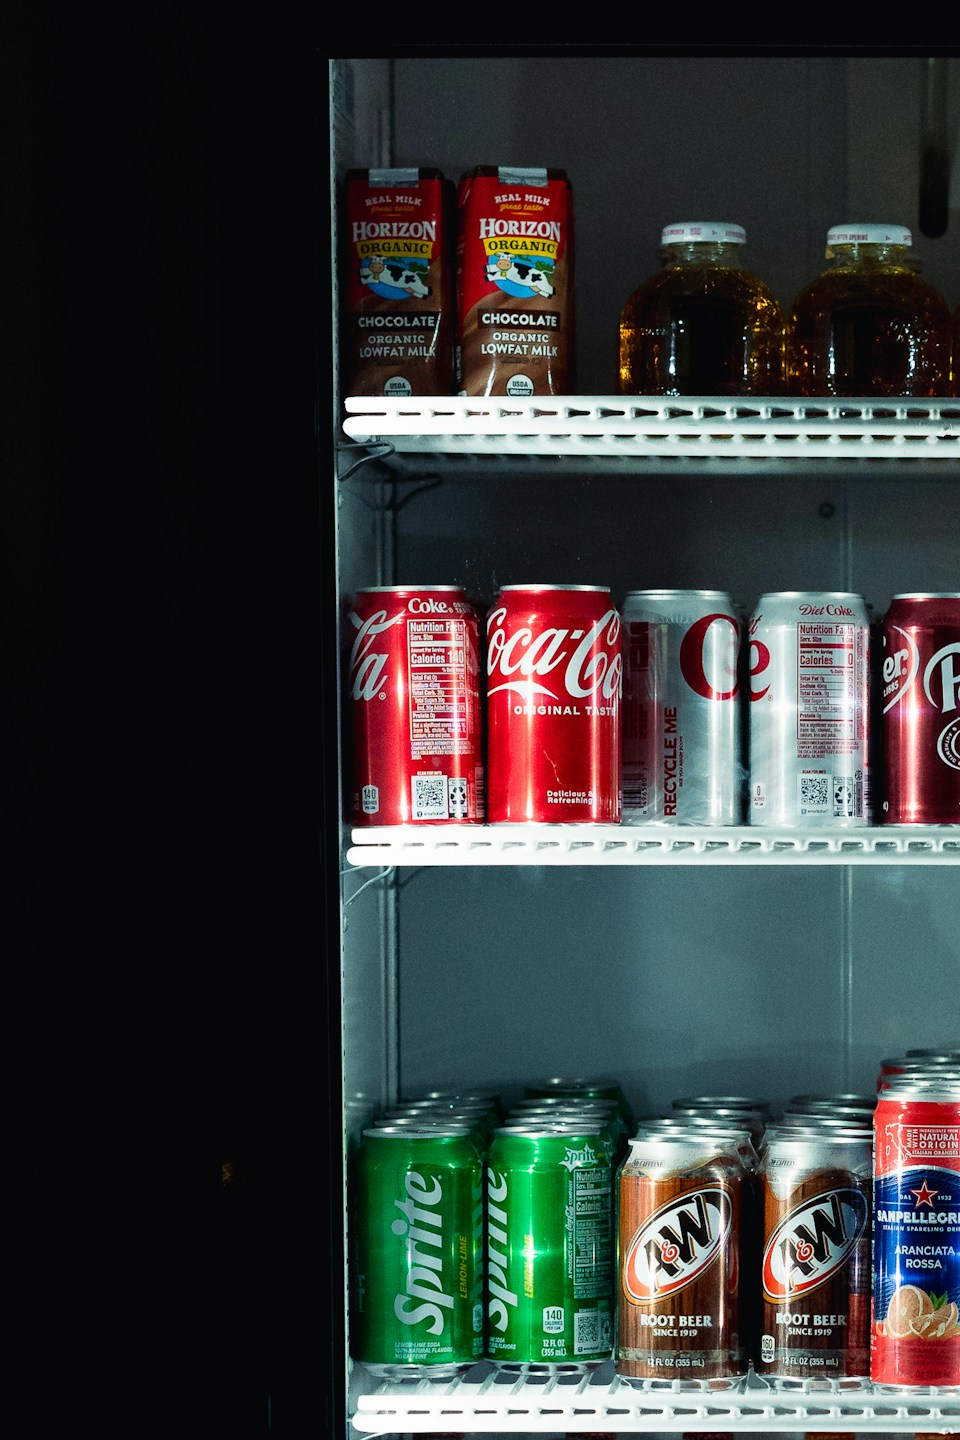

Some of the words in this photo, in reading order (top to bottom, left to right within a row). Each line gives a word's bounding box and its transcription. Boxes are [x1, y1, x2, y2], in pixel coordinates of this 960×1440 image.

[365, 196, 392, 206] REAL
[395, 195, 422, 206] MILK
[495, 194, 521, 204] REAL
[524, 193, 551, 206] MILK
[353, 220, 436, 242] HORIZON
[479, 218, 561, 242] HORIZON
[360, 242, 430, 255] ORGANIC
[488, 240, 556, 254] ORGANIC
[358, 316, 435, 327] CHOCOLATE
[482, 313, 557, 327] CHOCOLATE
[368, 335, 425, 344] ORGANIC
[492, 332, 549, 343] ORGANIC
[359, 346, 405, 358] LOWFAT
[407, 345, 436, 357] MILK
[481, 343, 528, 356] LOWFAT
[531, 344, 558, 357] MILK
[408, 597, 448, 614] Coke
[410, 621, 444, 633] Nutrition
[445, 621, 463, 632] Fcts
[800, 655, 833, 665] Calories
[848, 652, 854, 666] 0
[663, 707, 677, 734] ME
[663, 738, 677, 816] RECYCLE
[547, 797, 593, 805] Refreshing
[920, 1133, 959, 1141] NATURAL
[920, 1141, 959, 1149] ORIGIN
[565, 1149, 596, 1165] Sprite
[643, 1193, 716, 1293] A&W
[778, 1193, 850, 1293] A&W
[391, 1171, 455, 1336] Sprite
[894, 1246, 955, 1256] ARANCIATA
[460, 1235, 468, 1300] LEMON-LIME
[905, 1259, 942, 1269] ROSSA
[545, 1310, 562, 1320] 140
[640, 1314, 676, 1326] ROOT
[678, 1315, 713, 1327] BEER
[776, 1313, 811, 1325] ROOT
[813, 1313, 847, 1326] BEER
[652, 1328, 678, 1336] SINCE
[679, 1329, 698, 1337] 1919
[787, 1327, 813, 1336] SINCE
[814, 1327, 832, 1336] 1919
[543, 1339, 549, 1347] 12
[550, 1339, 556, 1347] FL
[557, 1339, 565, 1347] OZ
